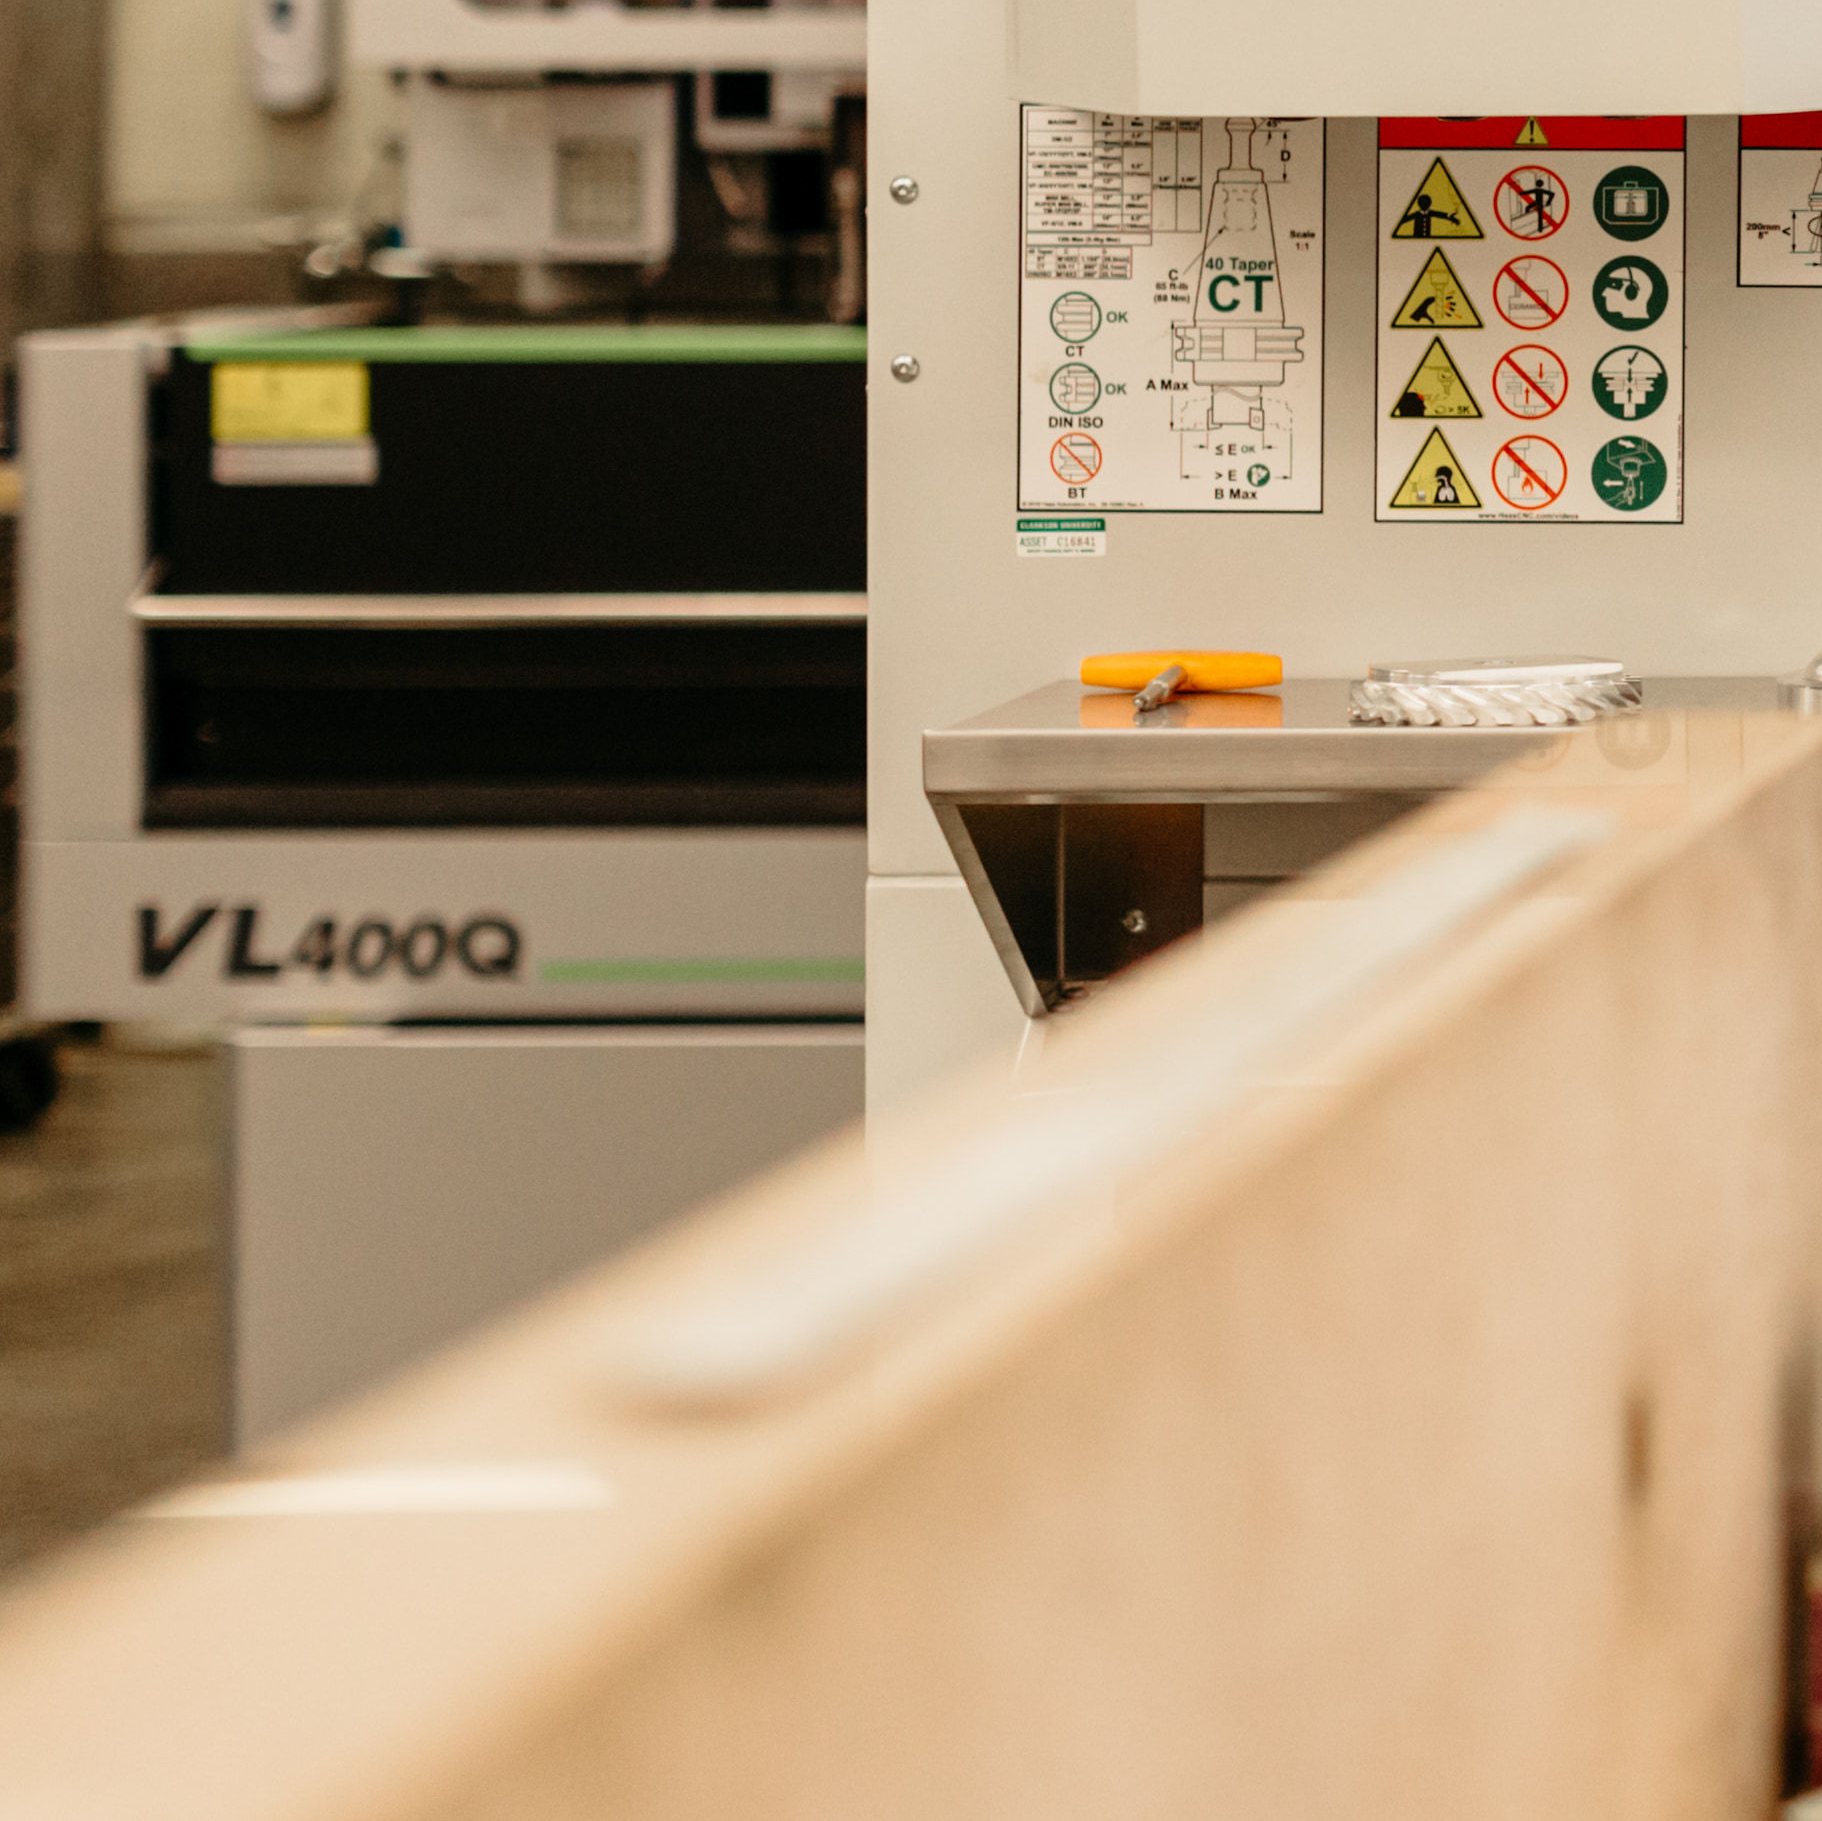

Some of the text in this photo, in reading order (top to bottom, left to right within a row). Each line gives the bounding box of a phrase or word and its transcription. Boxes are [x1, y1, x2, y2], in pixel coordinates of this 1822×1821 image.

[1280, 149, 1291, 162] D
[1289, 229, 1316, 239] Scale
[1205, 257, 1275, 275] 40 Taper
[1168, 268, 1179, 281] C
[1171, 292, 1190, 305] Nm)
[1207, 274, 1274, 313] CT
[1106, 310, 1128, 324] OK
[1065, 344, 1085, 358] CT
[1105, 382, 1127, 396] OK
[1146, 379, 1189, 392] A Max
[1049, 416, 1104, 429] DIN ISO
[1227, 443, 1256, 456] E OK
[1227, 469, 1237, 482] E
[1068, 486, 1087, 499] BT
[1214, 487, 1258, 500] B Max
[1020, 536, 1046, 547] ASSET
[136, 900, 523, 981] VL400Q
